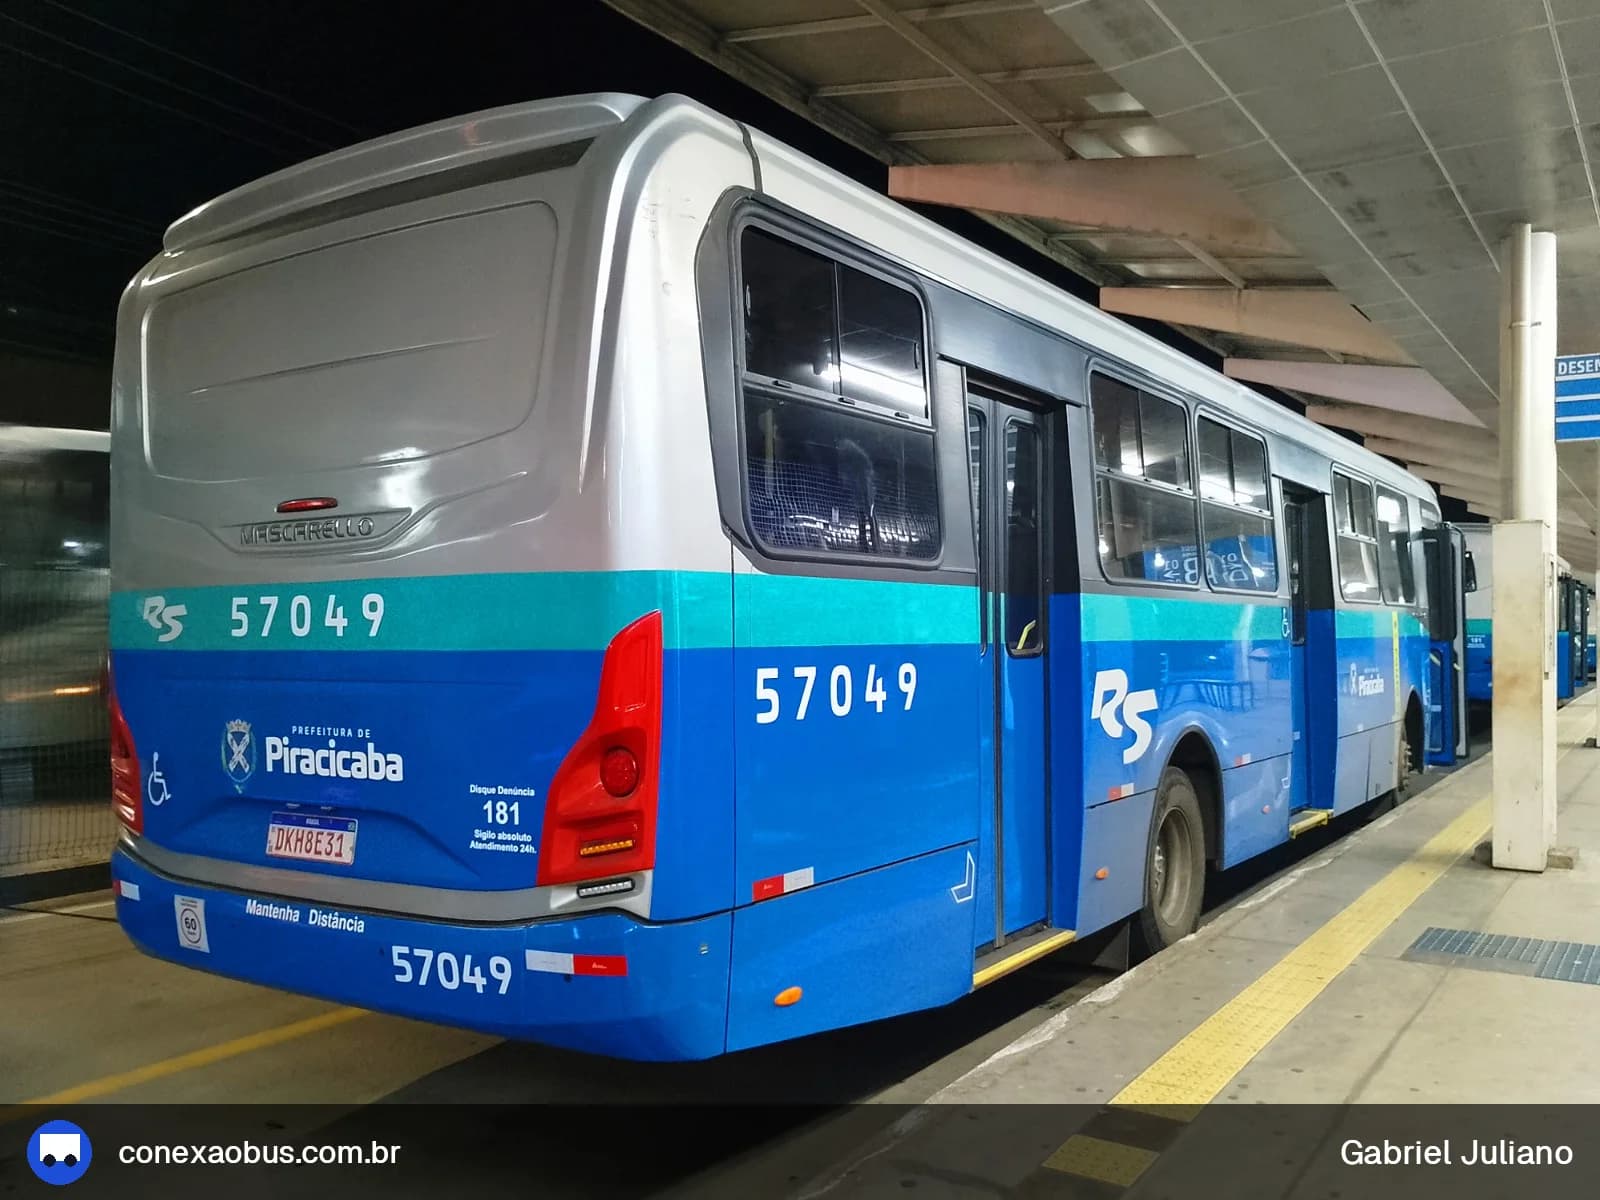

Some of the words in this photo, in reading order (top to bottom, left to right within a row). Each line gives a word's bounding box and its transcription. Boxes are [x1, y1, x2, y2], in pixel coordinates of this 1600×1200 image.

[240, 516, 376, 545] MASCARELLO
[143, 595, 188, 643] RS
[231, 593, 385, 637] 57049
[756, 662, 917, 725] 57049
[291, 725, 353, 738] PREFEITURA
[357, 728, 371, 738] DE
[1091, 668, 1158, 765] RS
[265, 736, 404, 782] Piracicaba
[469, 784, 496, 796] Disque
[497, 785, 535, 797] Denúncia
[483, 800, 520, 825] 181
[275, 827, 345, 858] DKH8E31
[469, 840, 519, 852] Atendimento
[519, 844, 537, 854] 24h.
[473, 829, 497, 841] Sigilo
[497, 831, 532, 842] absoluto
[184, 916, 197, 931] 60
[246, 899, 300, 923] Mantenha
[308, 909, 365, 933] Distância
[391, 945, 512, 995] 57049
